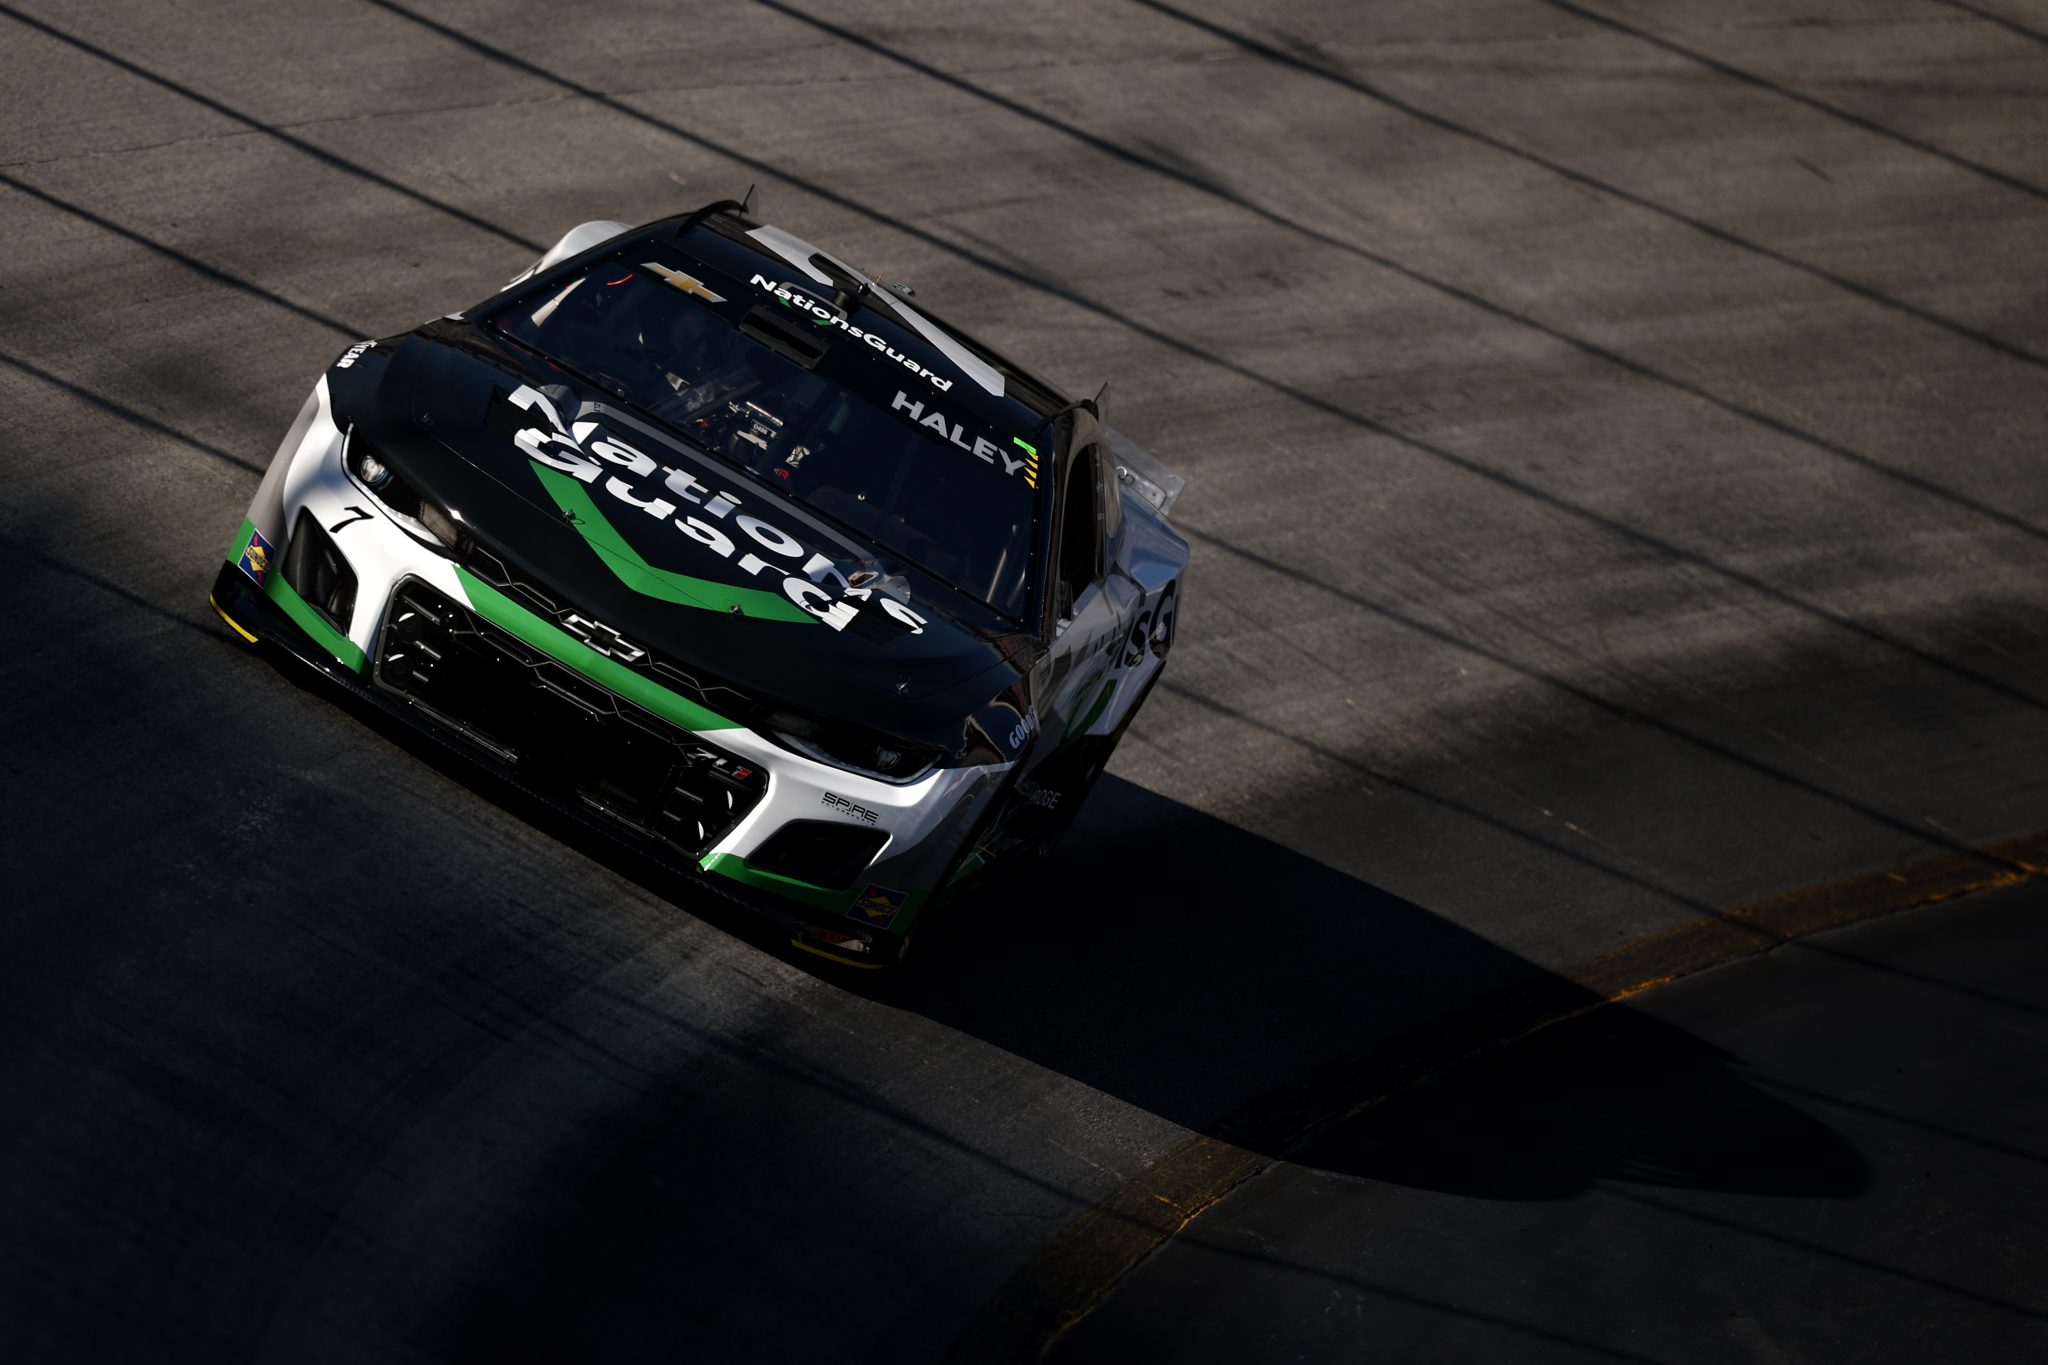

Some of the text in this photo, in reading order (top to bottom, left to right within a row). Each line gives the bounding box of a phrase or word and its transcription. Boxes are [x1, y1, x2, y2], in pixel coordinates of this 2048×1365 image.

[749, 272, 954, 393] NationsGuard
[891, 390, 1026, 477] HALEY
[329, 506, 374, 533] 7
[508, 384, 928, 634] Nations
[513, 425, 861, 632] Guard
[822, 791, 880, 823] SPIRE
